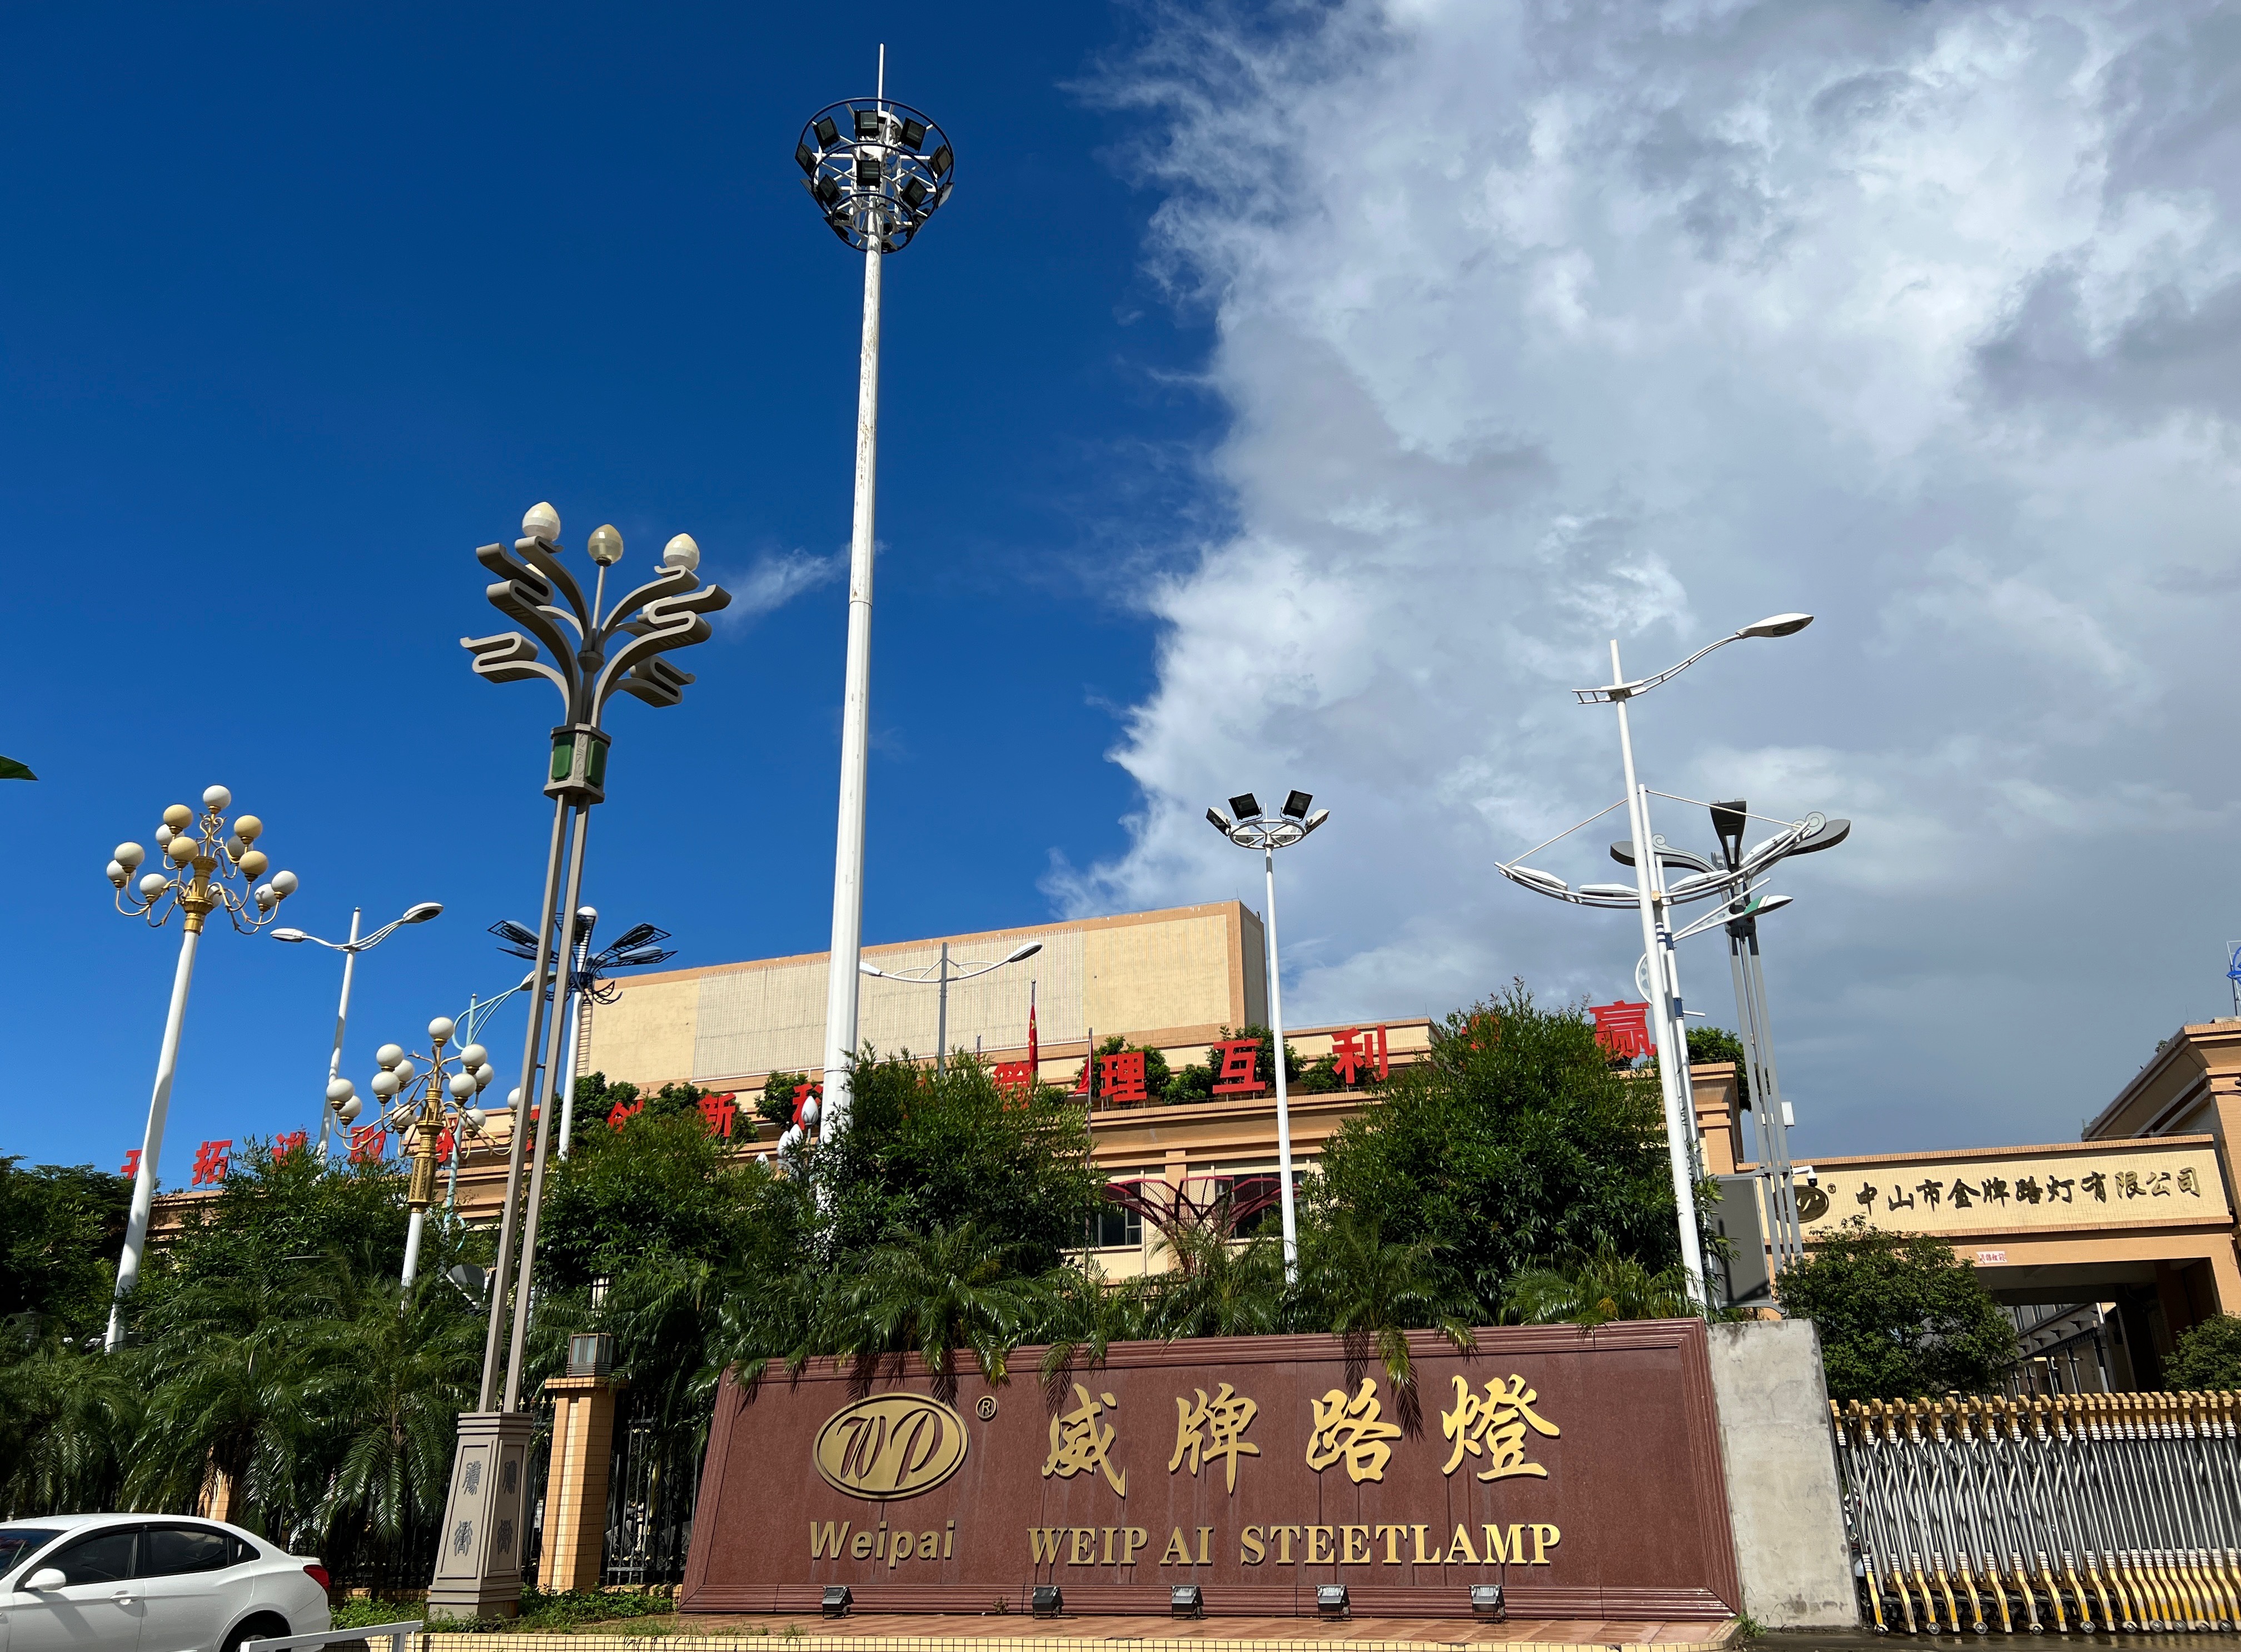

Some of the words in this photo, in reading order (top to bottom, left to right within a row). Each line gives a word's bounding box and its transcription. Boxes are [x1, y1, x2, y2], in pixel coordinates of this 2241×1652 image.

[1856, 1167, 2200, 1216] 中山市金牌路灯有限公司
[810, 1520, 956, 1570] Weipai
[1241, 1523, 1561, 1566] STEETLAMP
